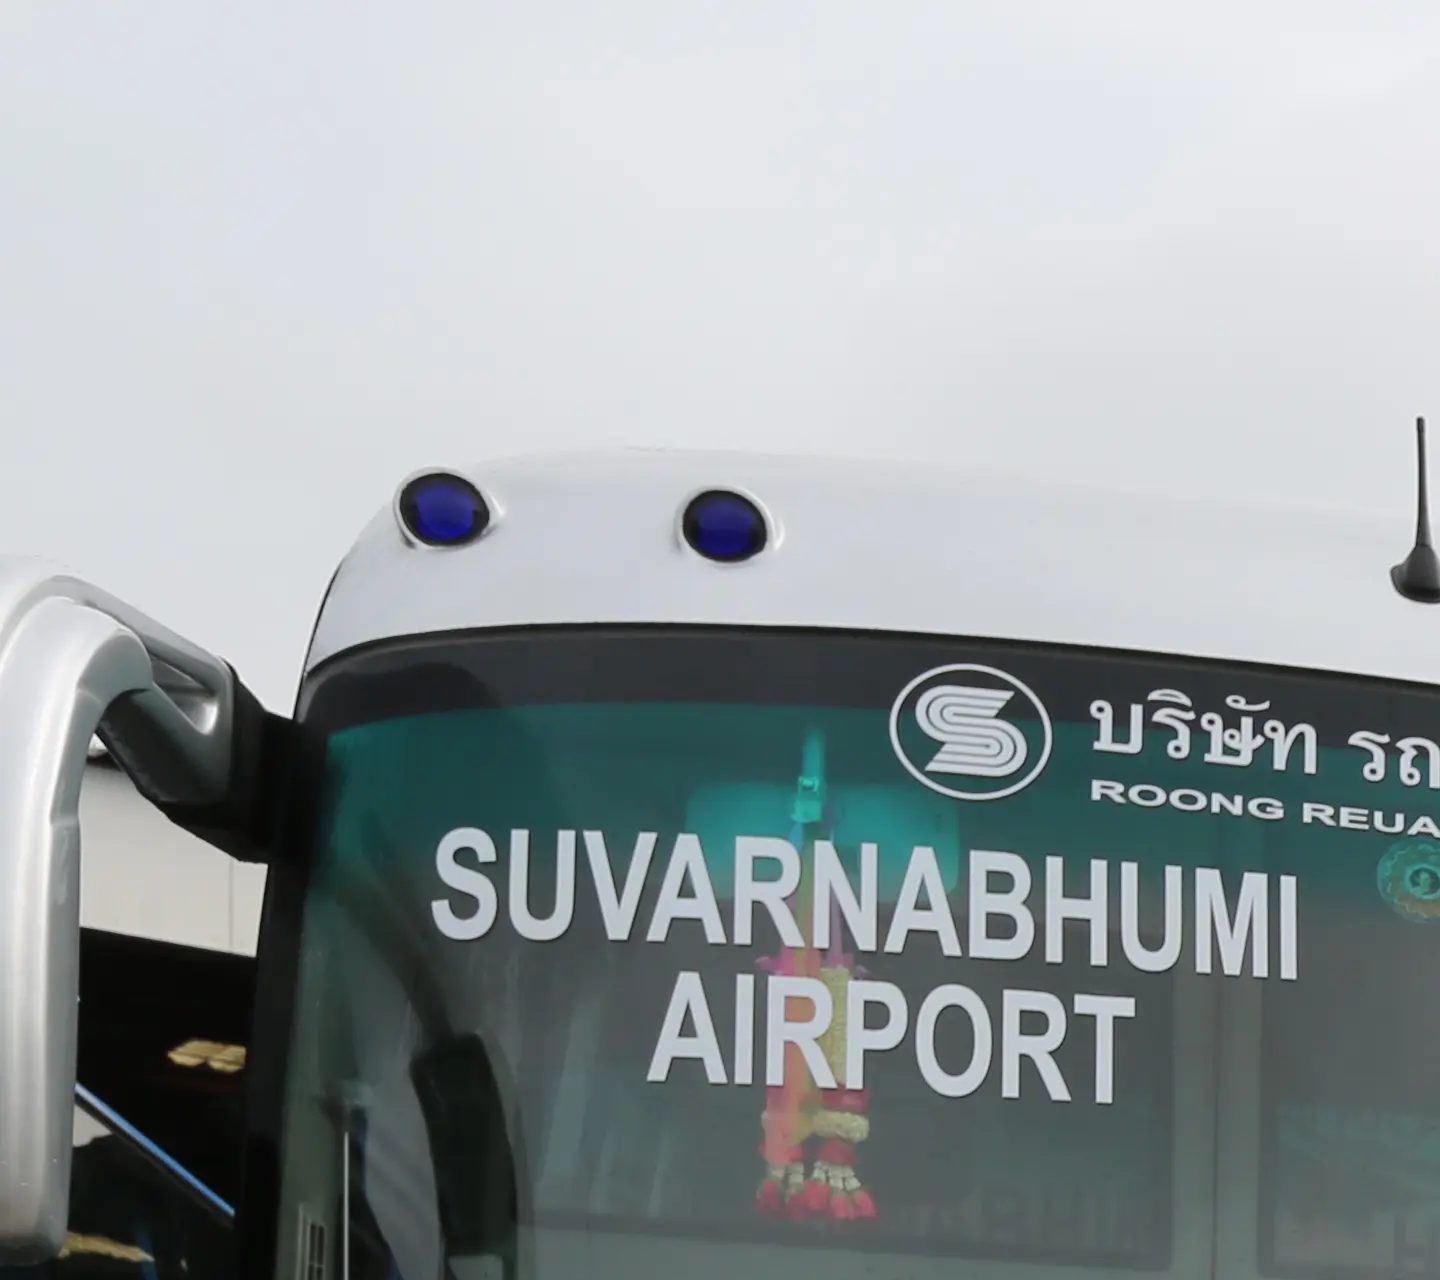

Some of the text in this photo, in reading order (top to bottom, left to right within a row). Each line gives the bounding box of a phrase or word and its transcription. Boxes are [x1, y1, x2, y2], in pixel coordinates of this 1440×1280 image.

[1089, 688, 1319, 775] บริษัท
[1091, 780, 1283, 822] ROONG
[430, 827, 1298, 980] SUVARNABHUMI
[647, 971, 1135, 1104] AIRPORT
